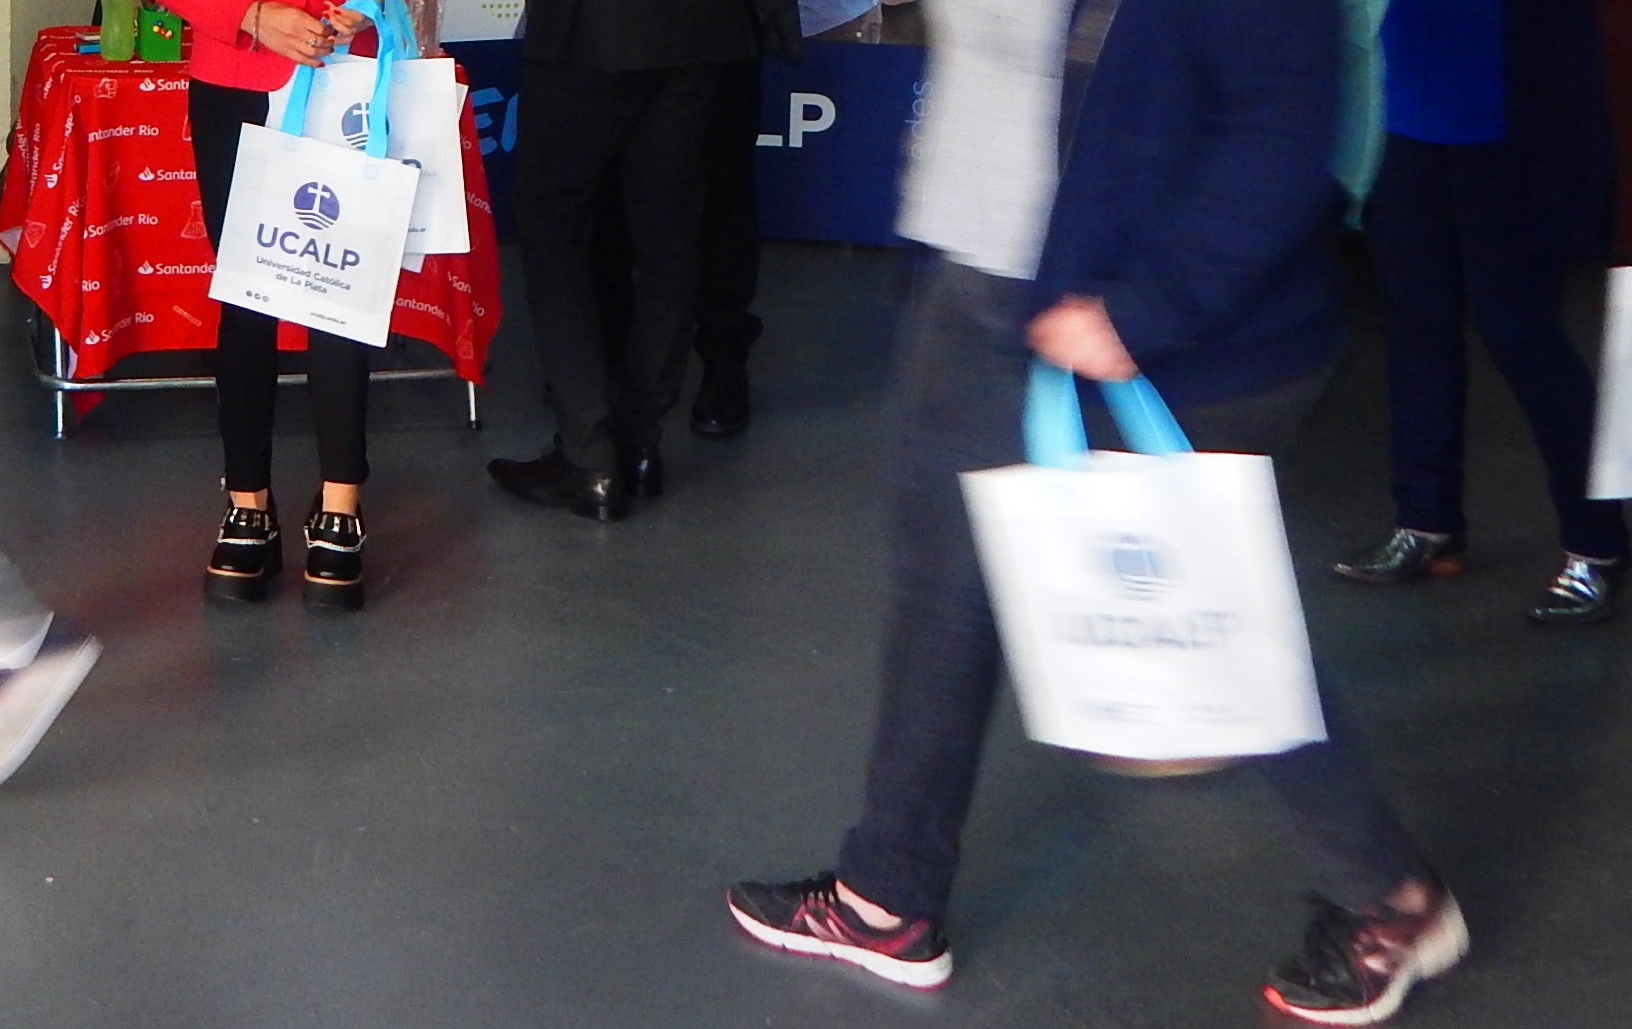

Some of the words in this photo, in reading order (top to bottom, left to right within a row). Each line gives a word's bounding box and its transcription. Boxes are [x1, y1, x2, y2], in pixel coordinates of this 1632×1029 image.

[256, 223, 361, 271] UCALP
[155, 263, 217, 275] Santande
[256, 255, 312, 278] Universidad
[313, 272, 352, 291] Católica
[275, 272, 288, 282] de
[290, 276, 302, 286] La
[304, 280, 328, 294] Plata
